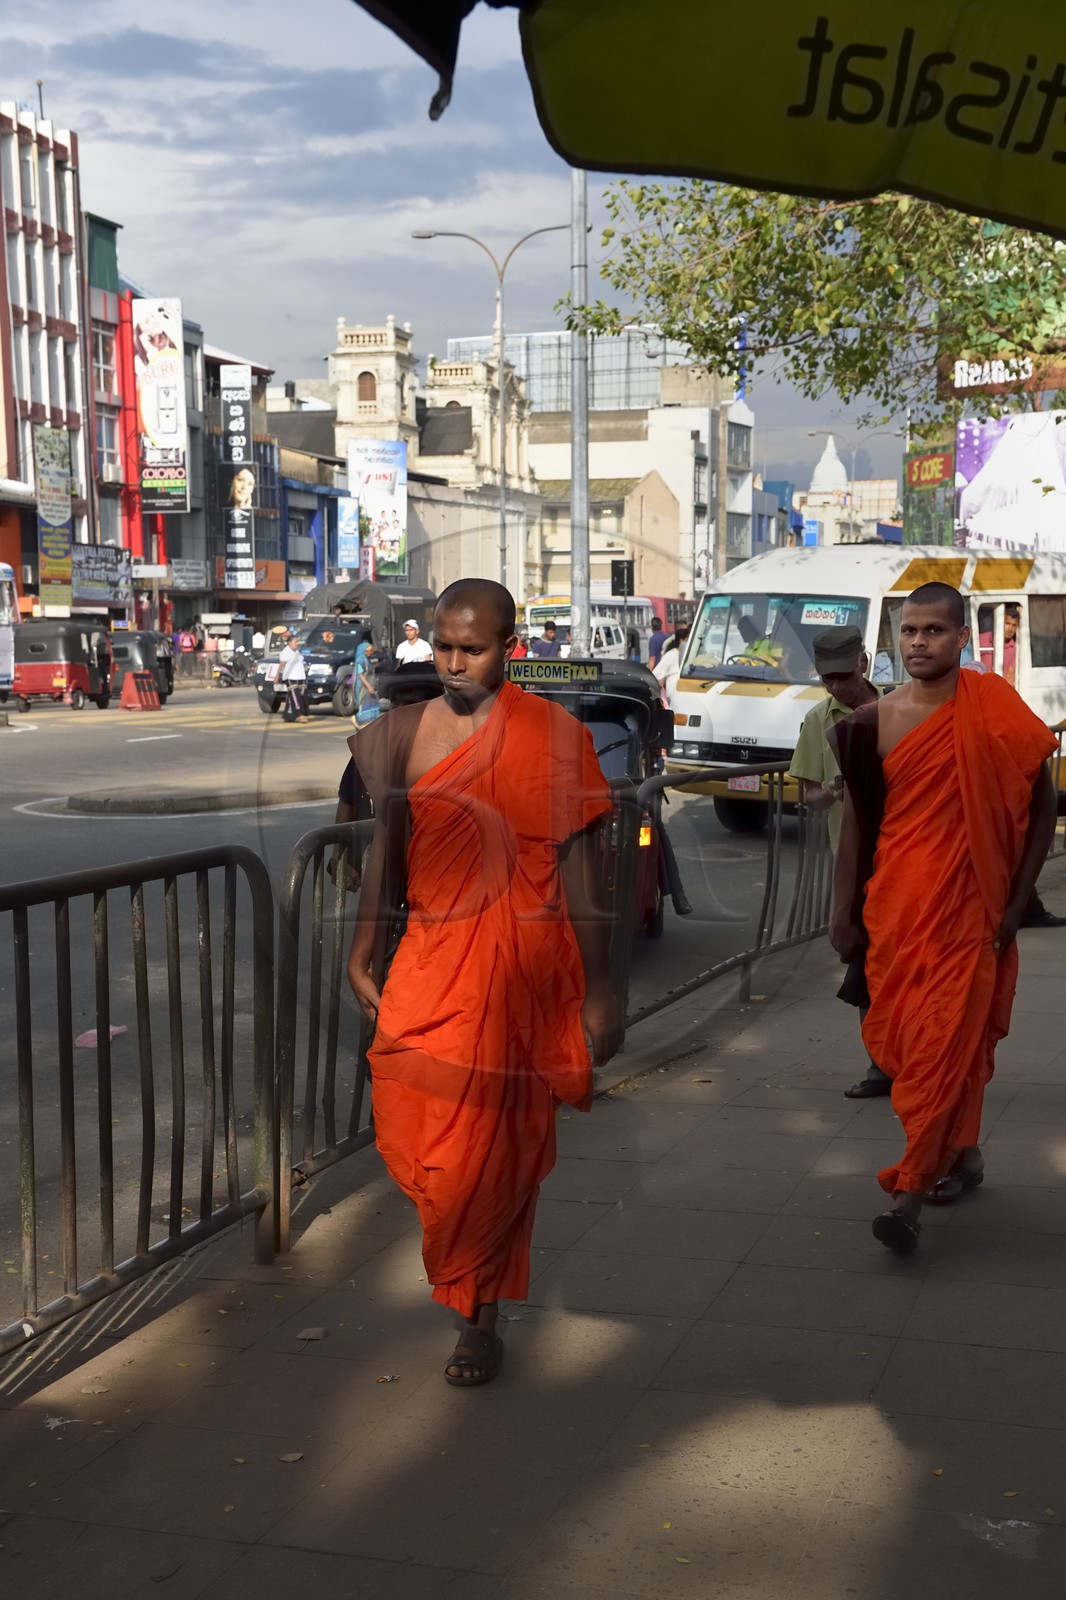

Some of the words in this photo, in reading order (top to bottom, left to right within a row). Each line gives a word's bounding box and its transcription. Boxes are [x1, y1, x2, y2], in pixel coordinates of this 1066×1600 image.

[142, 467, 186, 479] COLOMBO
[375, 472, 393, 481] DSI
[912, 461, 920, 482] 5
[512, 664, 569, 679] WELCOME
[571, 665, 598, 680] TAXI
[731, 736, 758, 745] ISUZU
